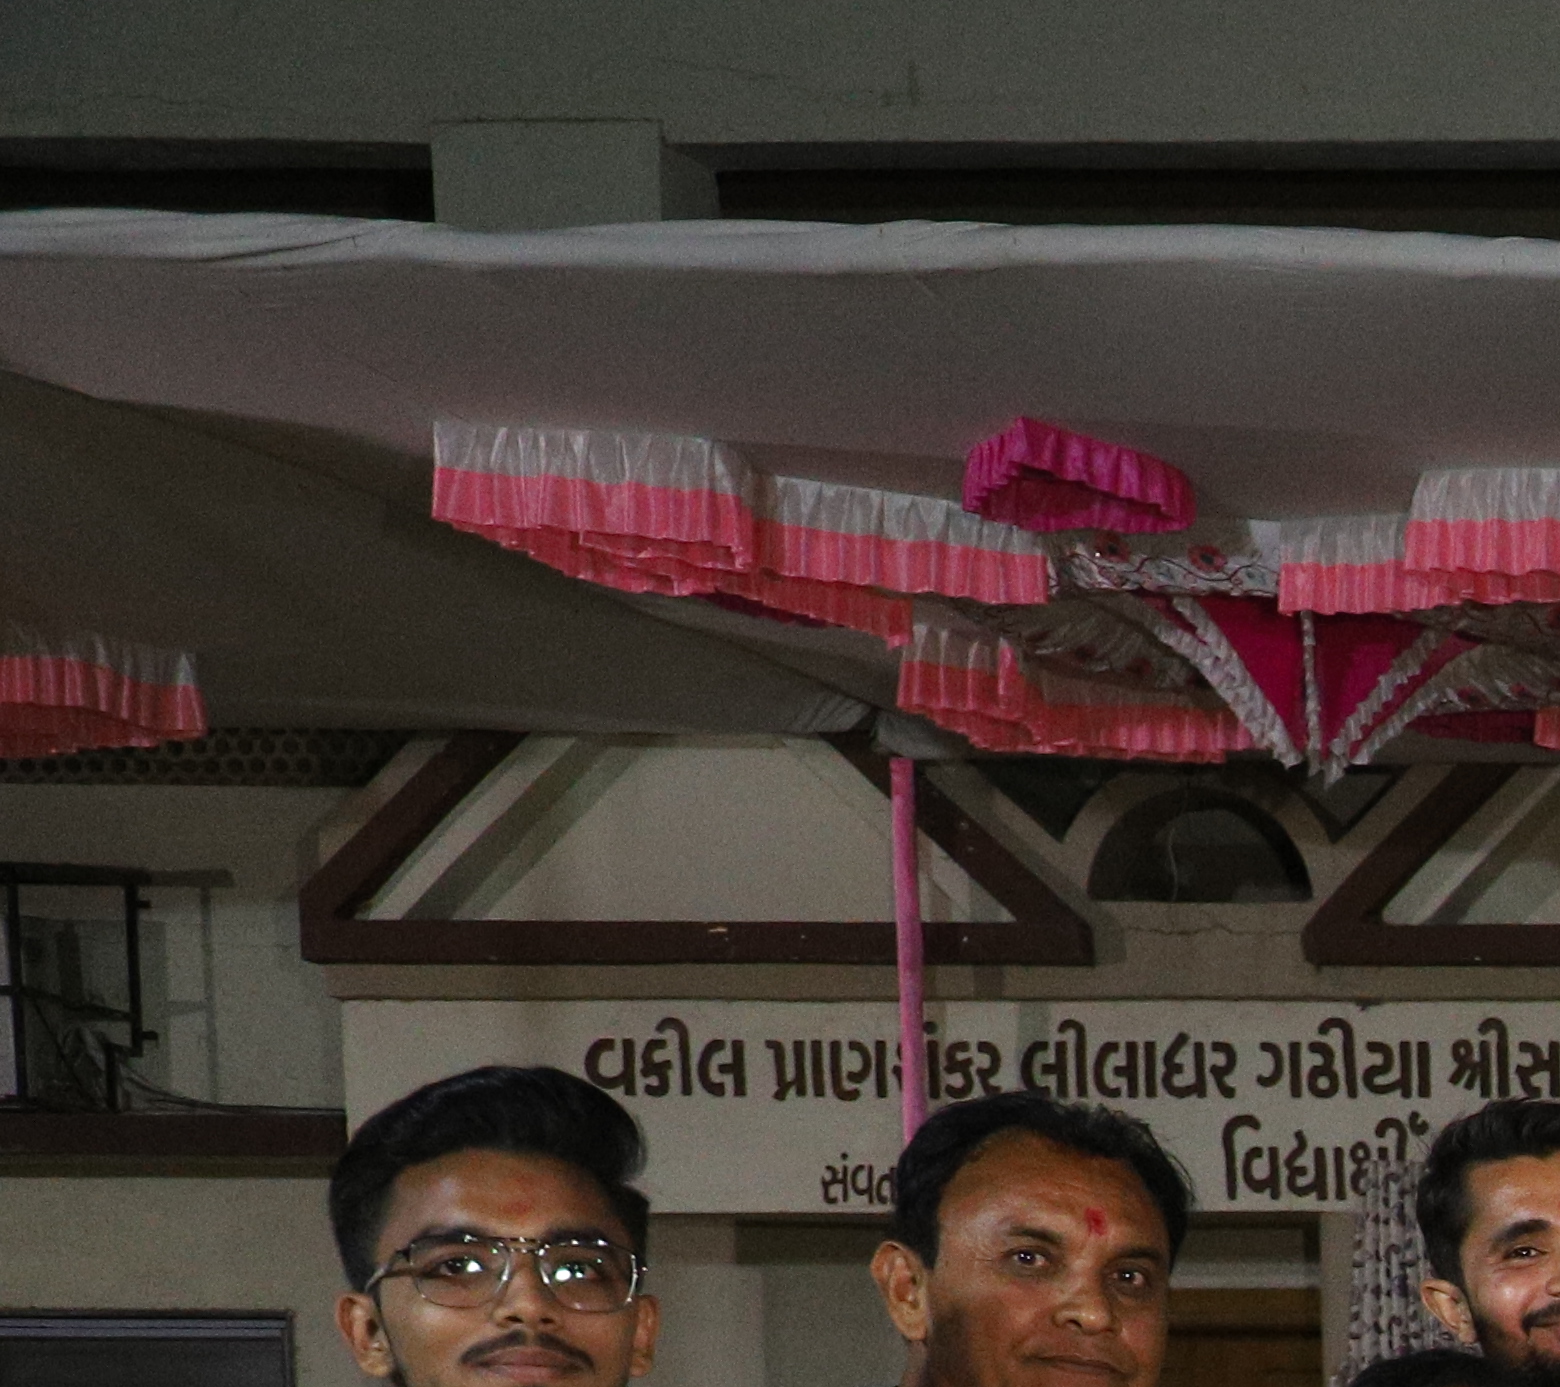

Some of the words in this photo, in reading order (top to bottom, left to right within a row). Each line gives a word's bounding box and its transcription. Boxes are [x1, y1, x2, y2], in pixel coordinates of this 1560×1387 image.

[583, 1017, 746, 1098] વકીલ
[1020, 1019, 1238, 1099] લીલાધર
[1257, 1017, 1432, 1099] ગઠીયા
